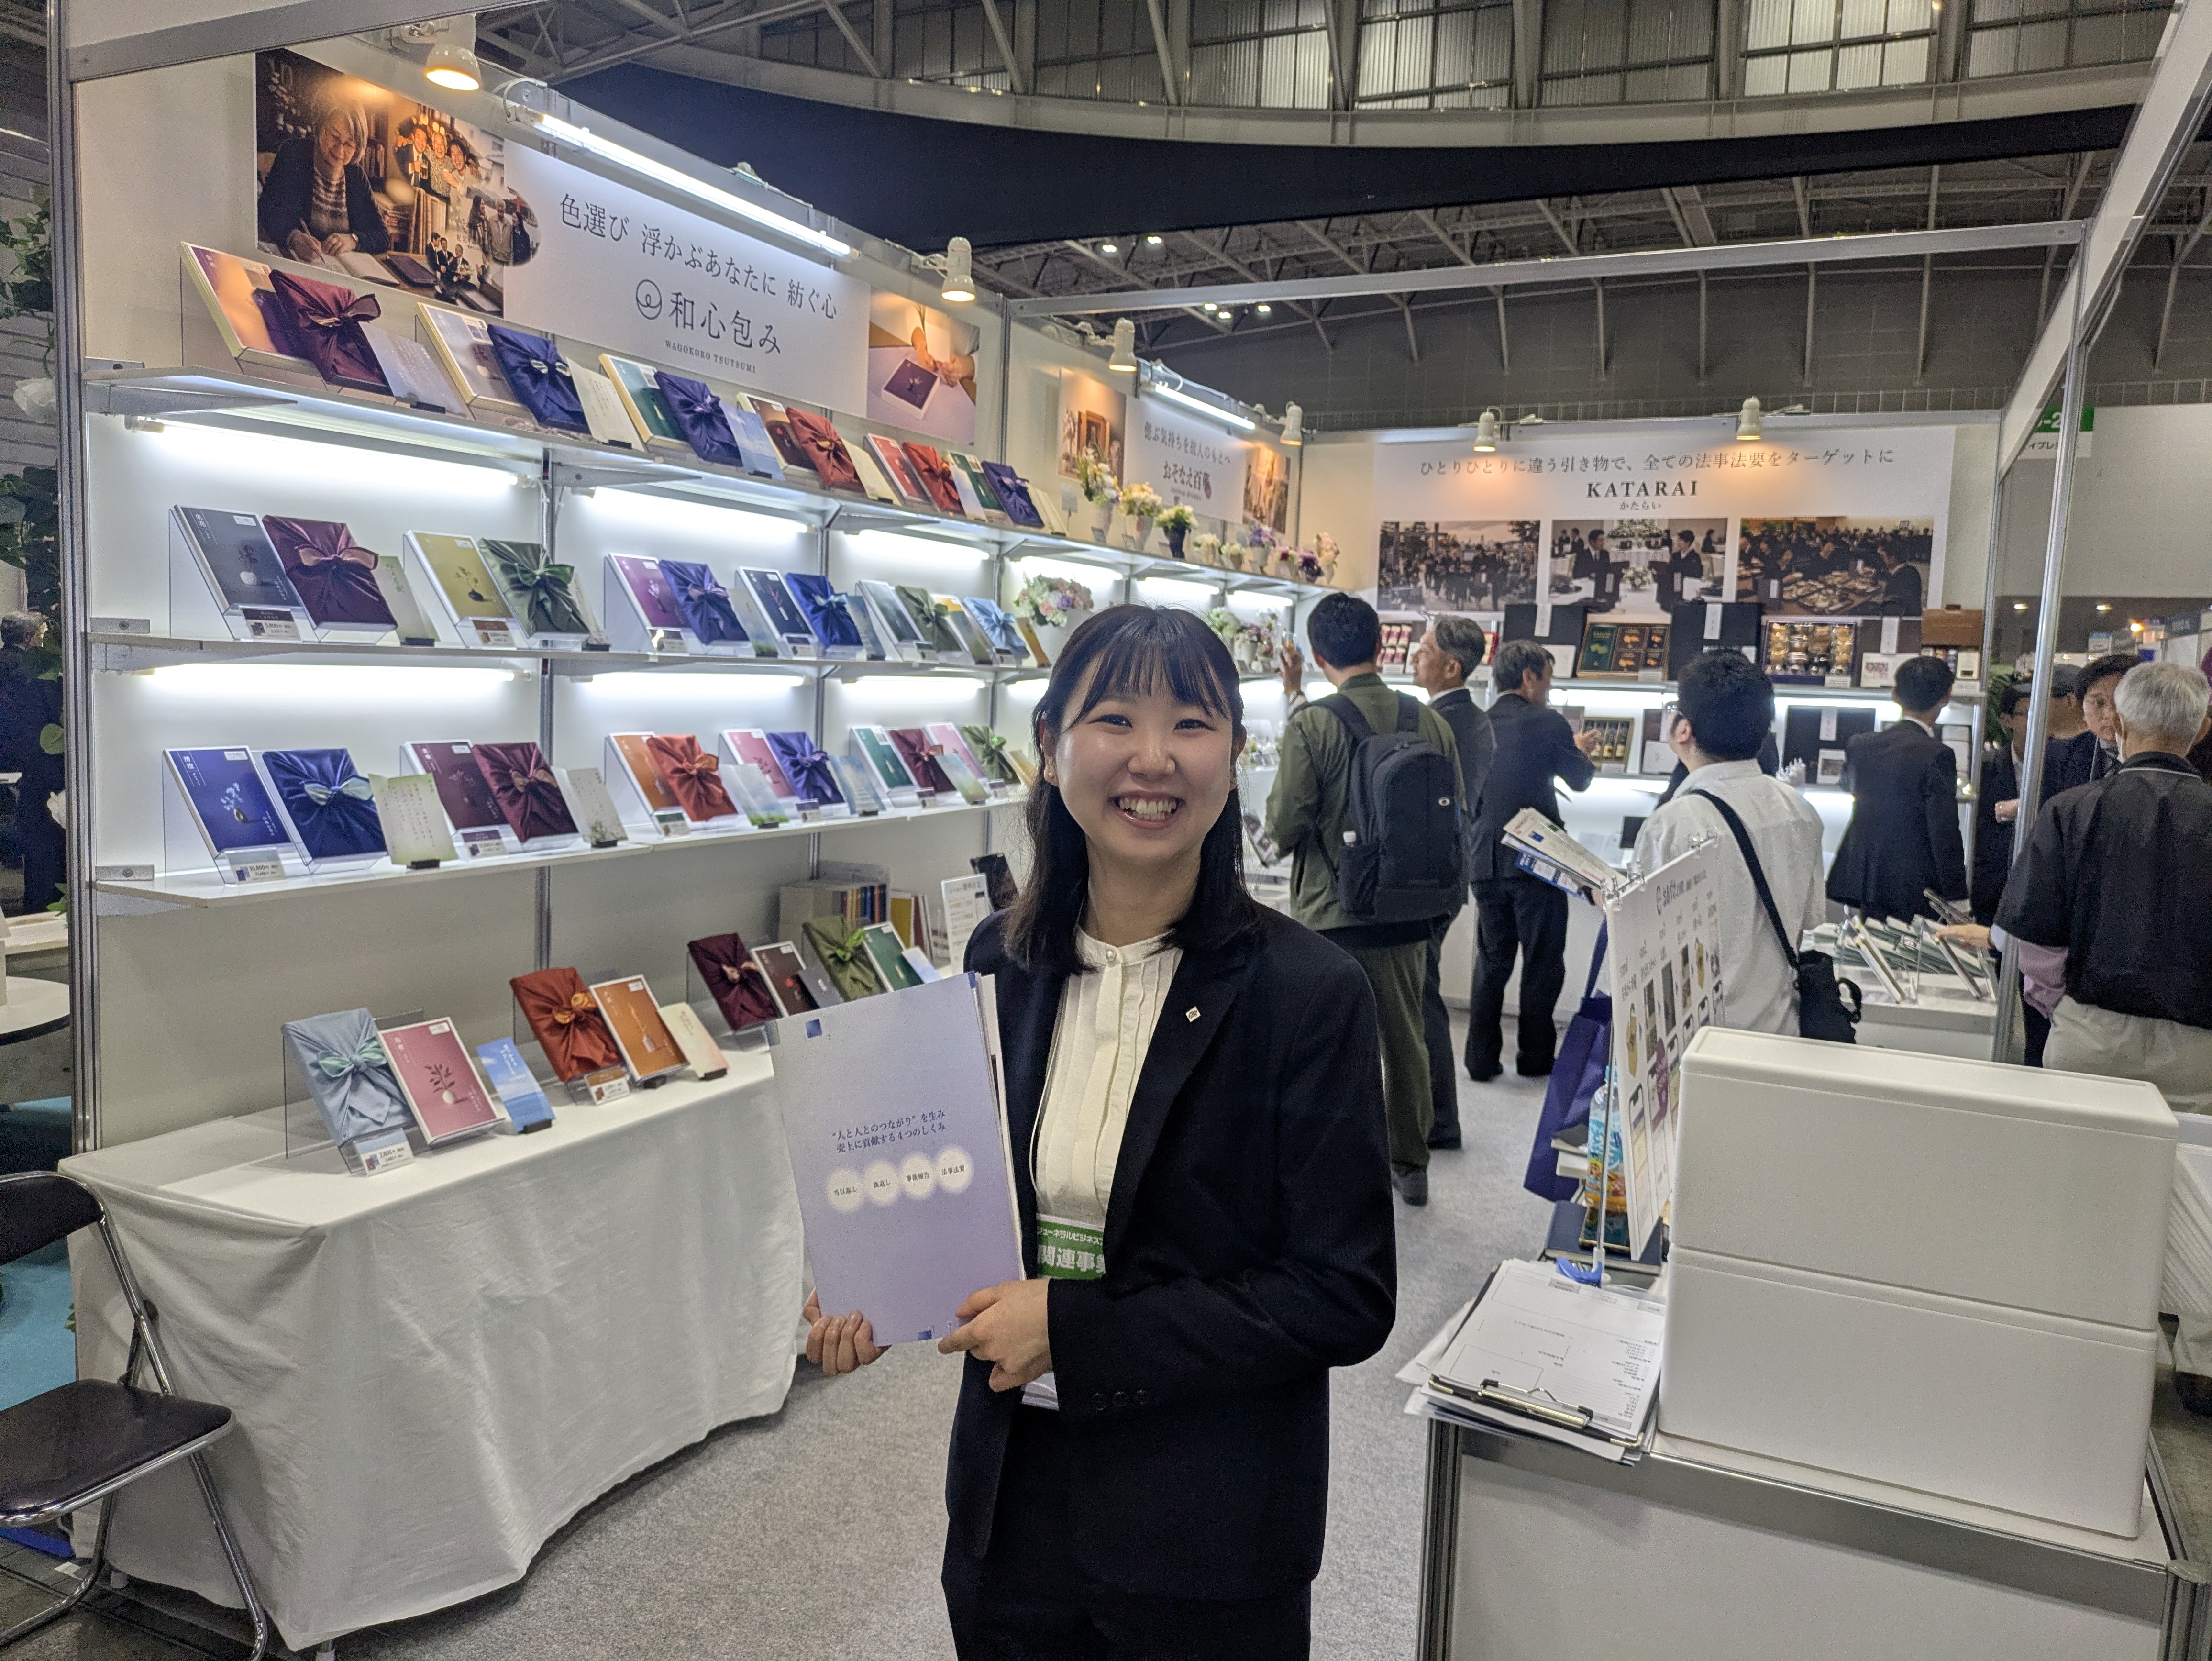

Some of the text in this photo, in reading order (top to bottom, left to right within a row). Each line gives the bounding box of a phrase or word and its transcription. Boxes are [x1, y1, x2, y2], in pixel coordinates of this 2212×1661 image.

[560, 193, 839, 319] 色選び 浮かぶあなたに 紡ぐ心
[669, 291, 783, 355] 和心包み
[665, 340, 756, 374] WAGOKORO TSUTSUMI
[1145, 421, 1231, 465] 偲ぶ気持ちを故人のもとへ
[1587, 480, 1698, 498] KATARAI
[1619, 501, 1662, 510] かたらい
[906, 1171, 929, 1182] 事後報告
[941, 1164, 965, 1175] 法事法要
[834, 1186, 857, 1196] 当日返し
[873, 1180, 891, 1188] 後返し
